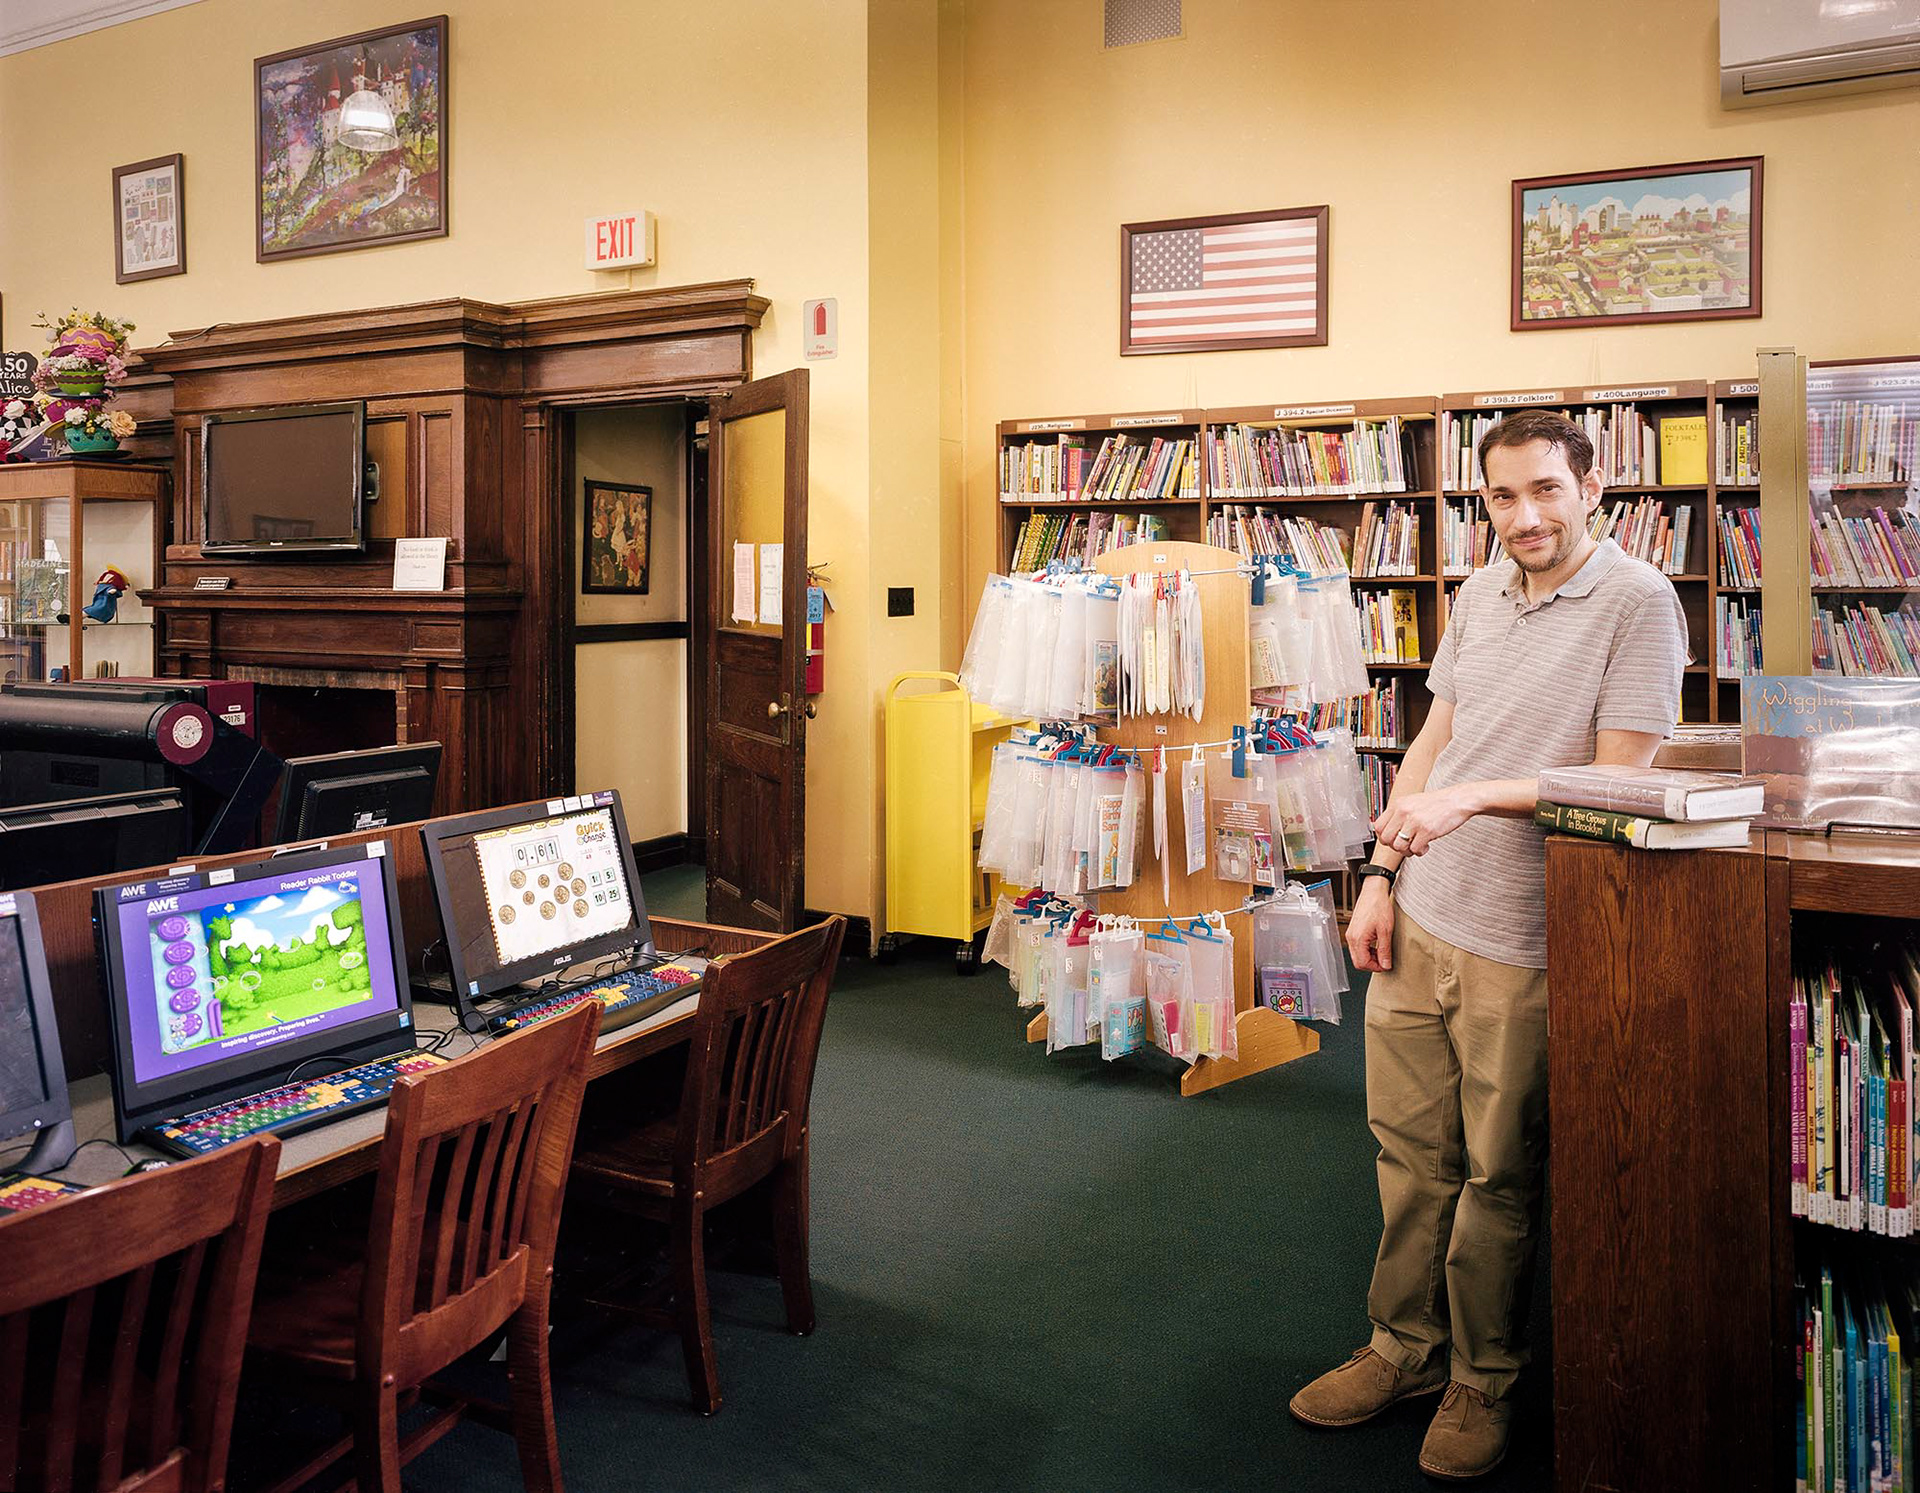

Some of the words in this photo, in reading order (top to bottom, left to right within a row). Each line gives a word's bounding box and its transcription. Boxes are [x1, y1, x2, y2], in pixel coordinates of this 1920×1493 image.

[597, 218, 636, 261] EXIT
[0, 357, 28, 372] 50
[1731, 385, 1737, 393] J
[1740, 385, 1759, 393] 500
[1492, 396, 1517, 404] 398.2
[1517, 394, 1555, 403] Folklore
[1283, 409, 1305, 417] 394.2
[1665, 424, 1708, 432] FOLKTALES
[1255, 555, 1261, 564] J
[1268, 555, 1276, 564] K
[1281, 556, 1289, 565] L
[1763, 682, 1853, 715] Wiggling
[1259, 723, 1266, 732] P
[1805, 719, 1823, 734] at
[1103, 800, 1122, 813] Happ
[1567, 809, 1573, 819] A
[1573, 809, 1586, 821] Tree
[1586, 812, 1607, 826] Grows
[1568, 820, 1575, 829] in
[1575, 820, 1603, 836] Brooklyn
[584, 832, 607, 844] Change
[281, 880, 307, 891] Reader
[308, 875, 331, 885] Rabbit
[331, 870, 358, 880] Toddler
[121, 884, 147, 898] AWE
[147, 896, 180, 914] AWE
[554, 955, 573, 966] ASUS
[221, 1036, 249, 1049] Inspiring
[248, 1028, 279, 1041] discovery.
[278, 1020, 306, 1033] Preparing
